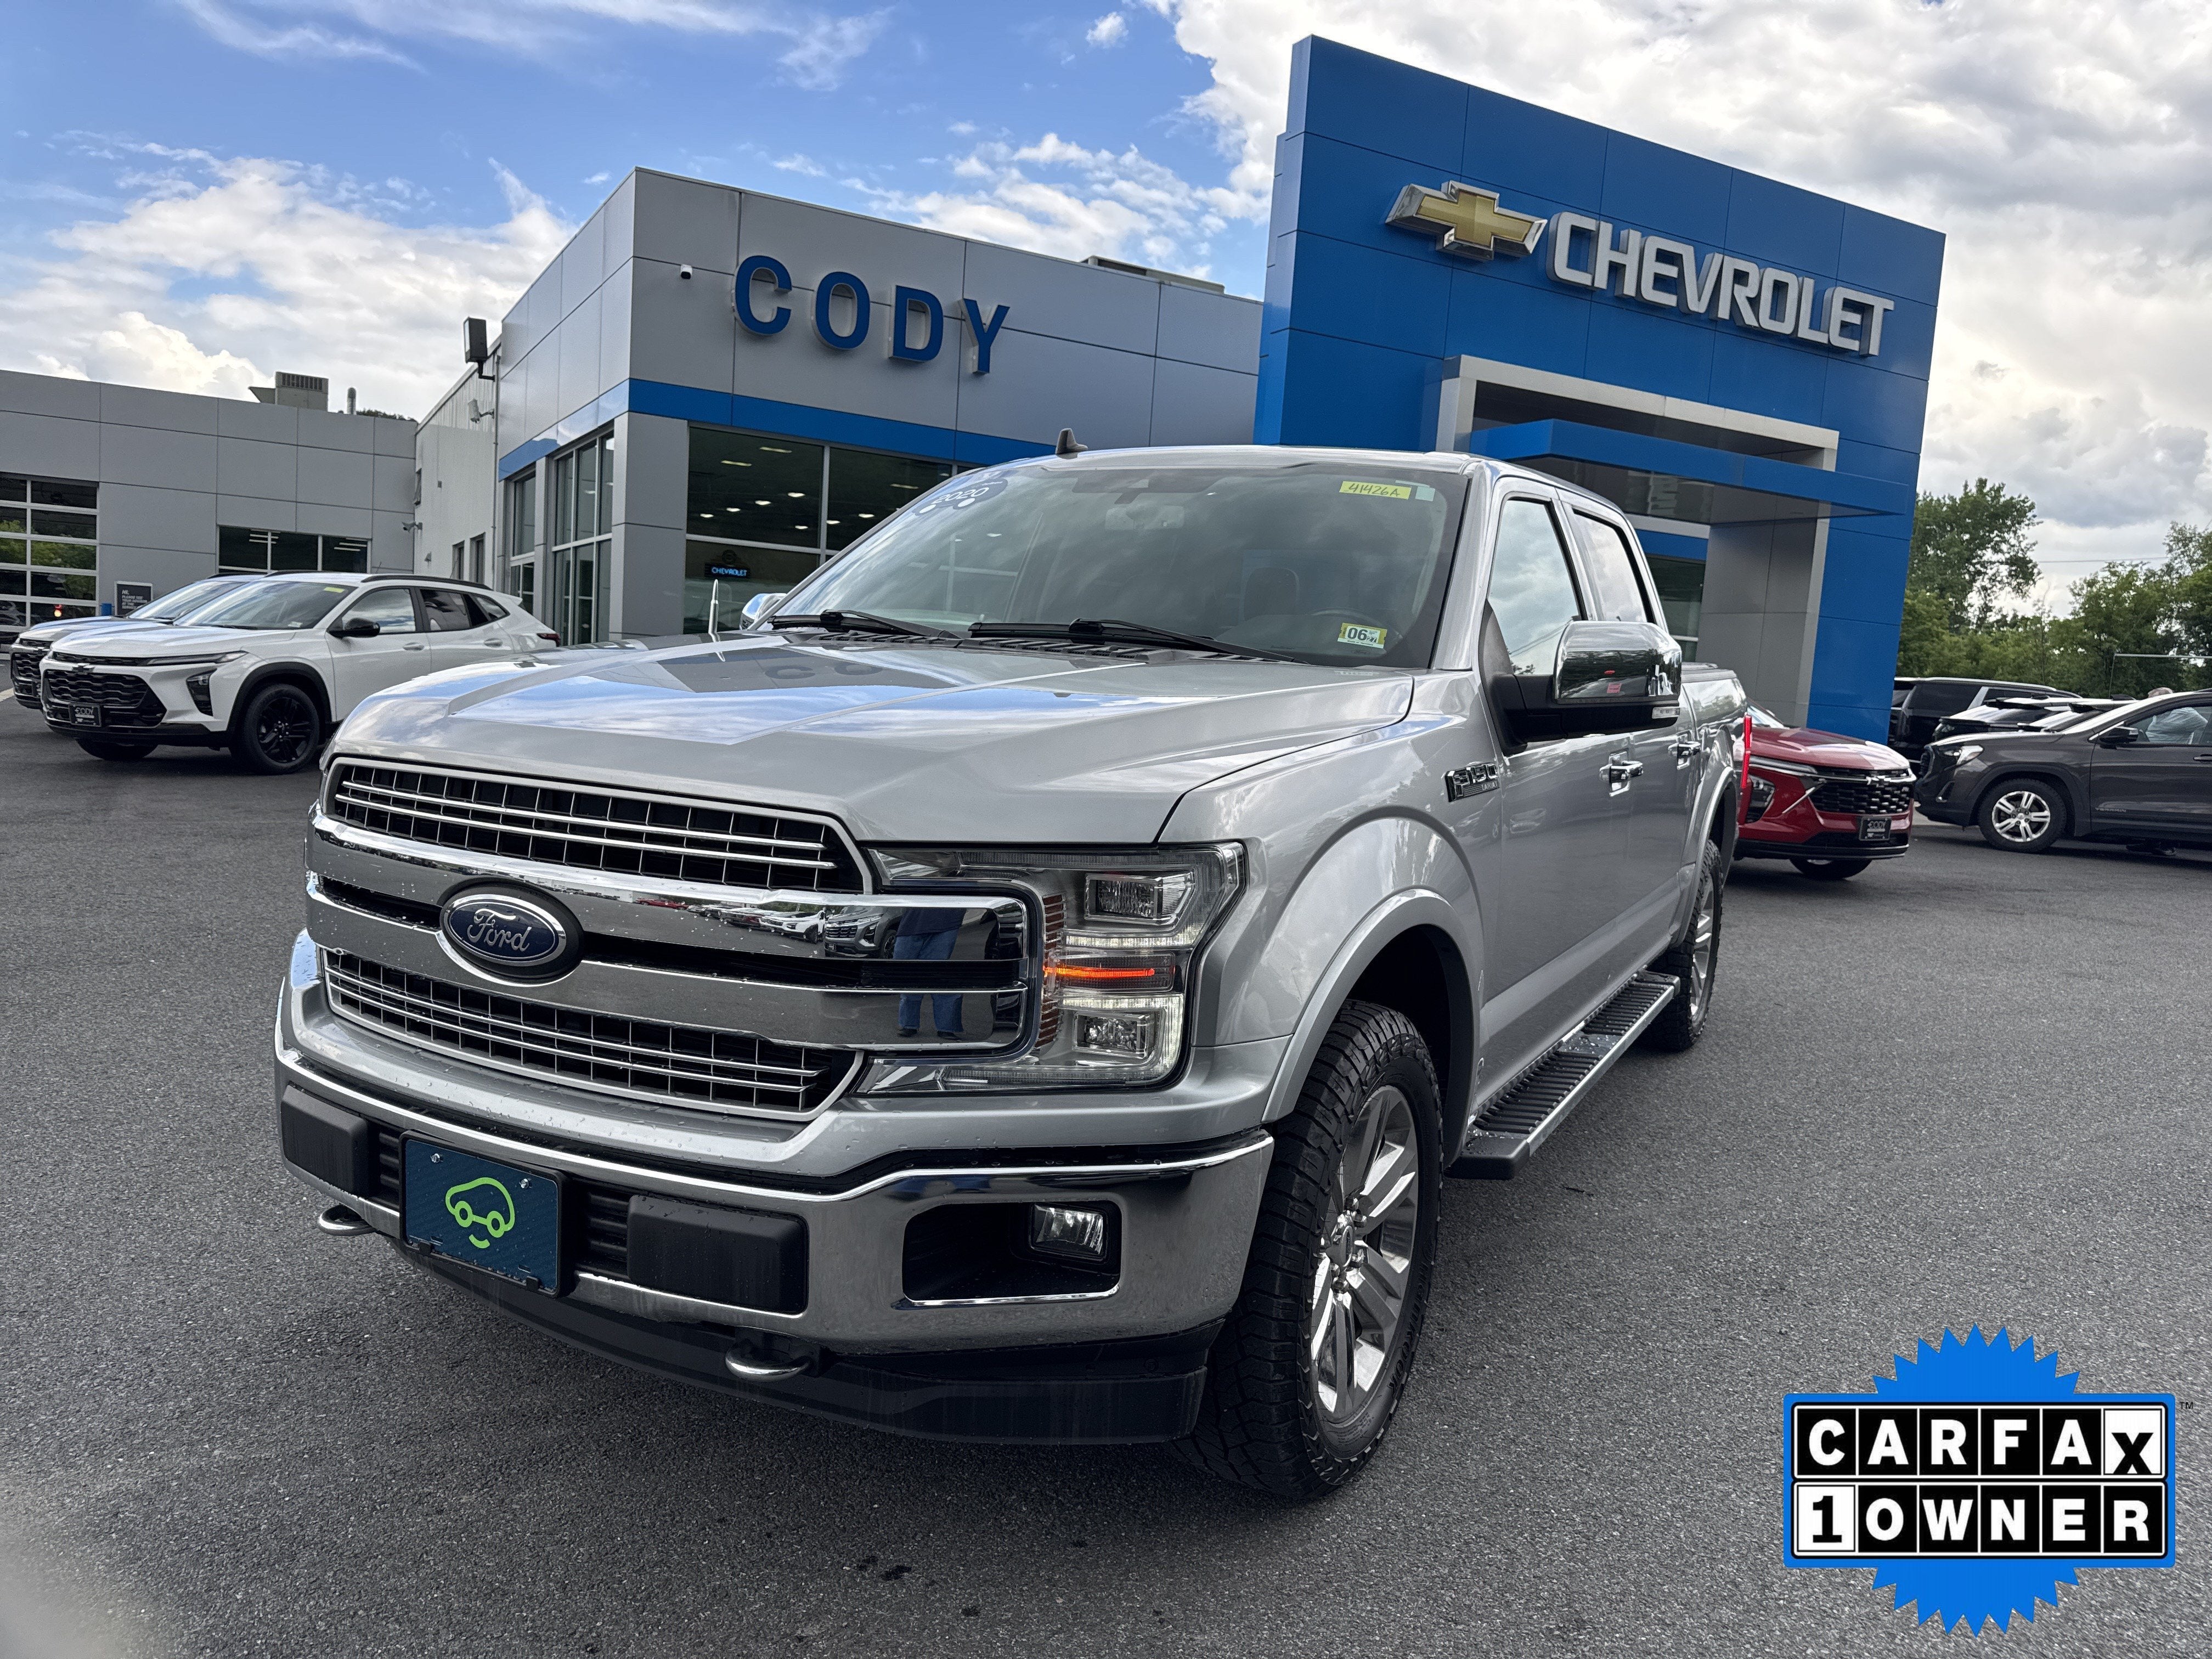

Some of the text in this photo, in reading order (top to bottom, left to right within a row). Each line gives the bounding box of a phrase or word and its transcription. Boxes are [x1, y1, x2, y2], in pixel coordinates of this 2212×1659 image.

[1547, 211, 1895, 358] CHEVROLET
[732, 255, 1011, 374] CODY
[931, 487, 990, 505] 2020
[1348, 483, 1401, 497] 41426A
[712, 567, 747, 577] CHEVROLET
[1347, 628, 1368, 641] 06
[1481, 781, 1499, 791] LARIAT
[467, 909, 532, 952] Ford
